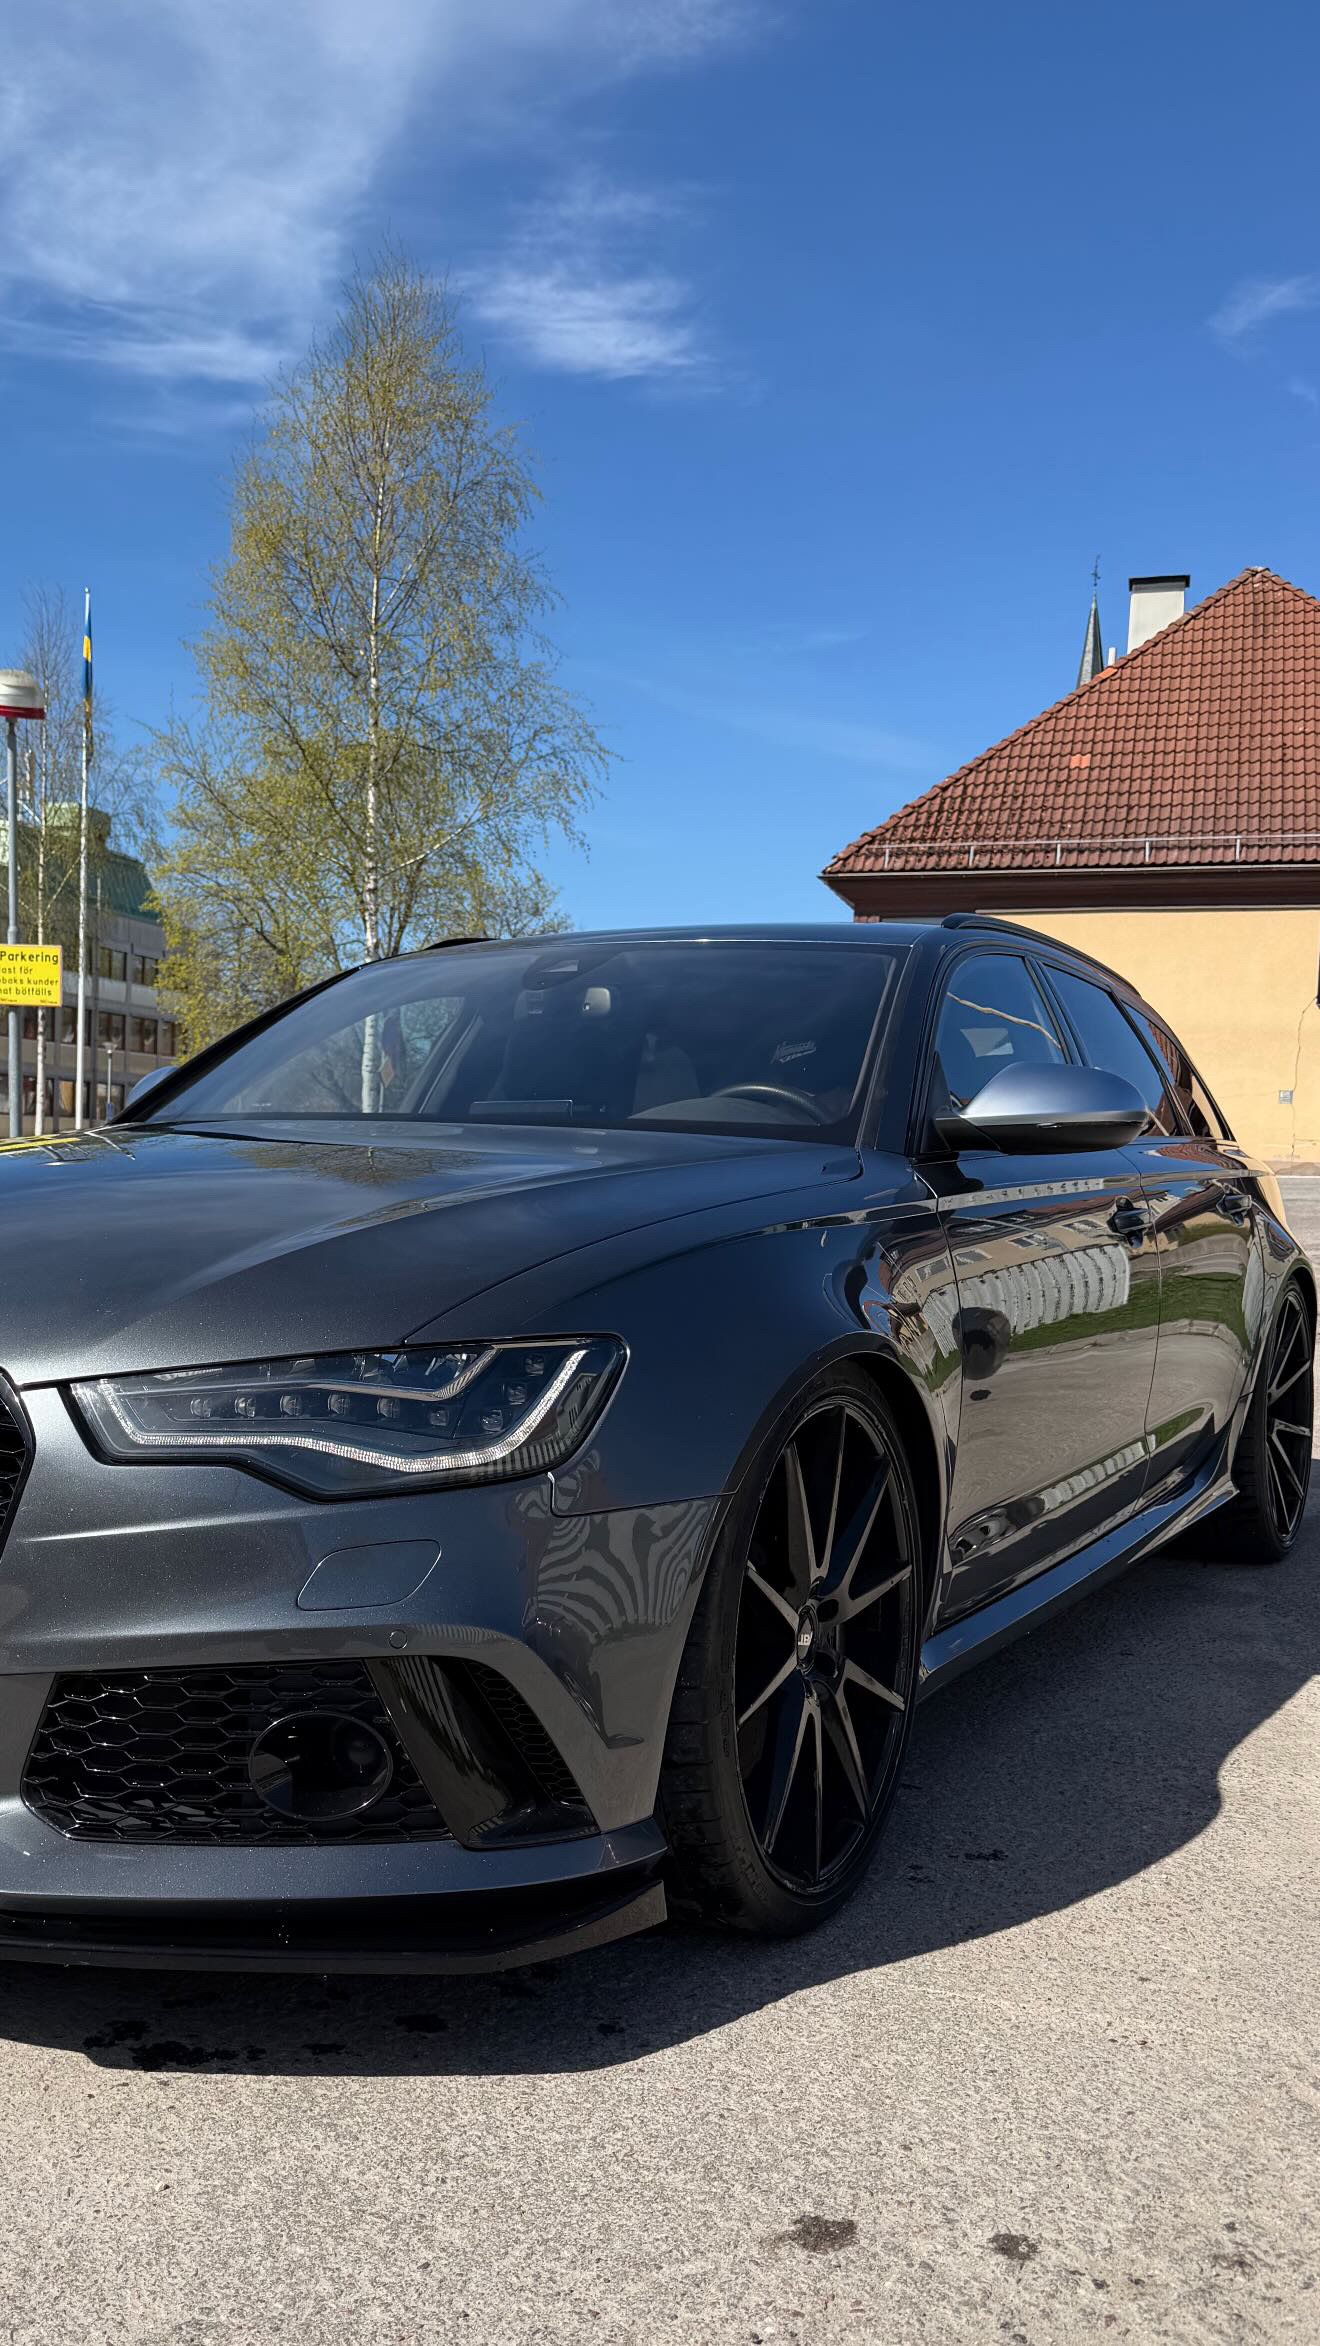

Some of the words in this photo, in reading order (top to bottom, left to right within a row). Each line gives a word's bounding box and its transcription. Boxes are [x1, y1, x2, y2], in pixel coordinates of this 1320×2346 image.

[0, 951, 58, 965] Parkering
[0, 977, 24, 985] baks
[27, 977, 59, 986] kunder
